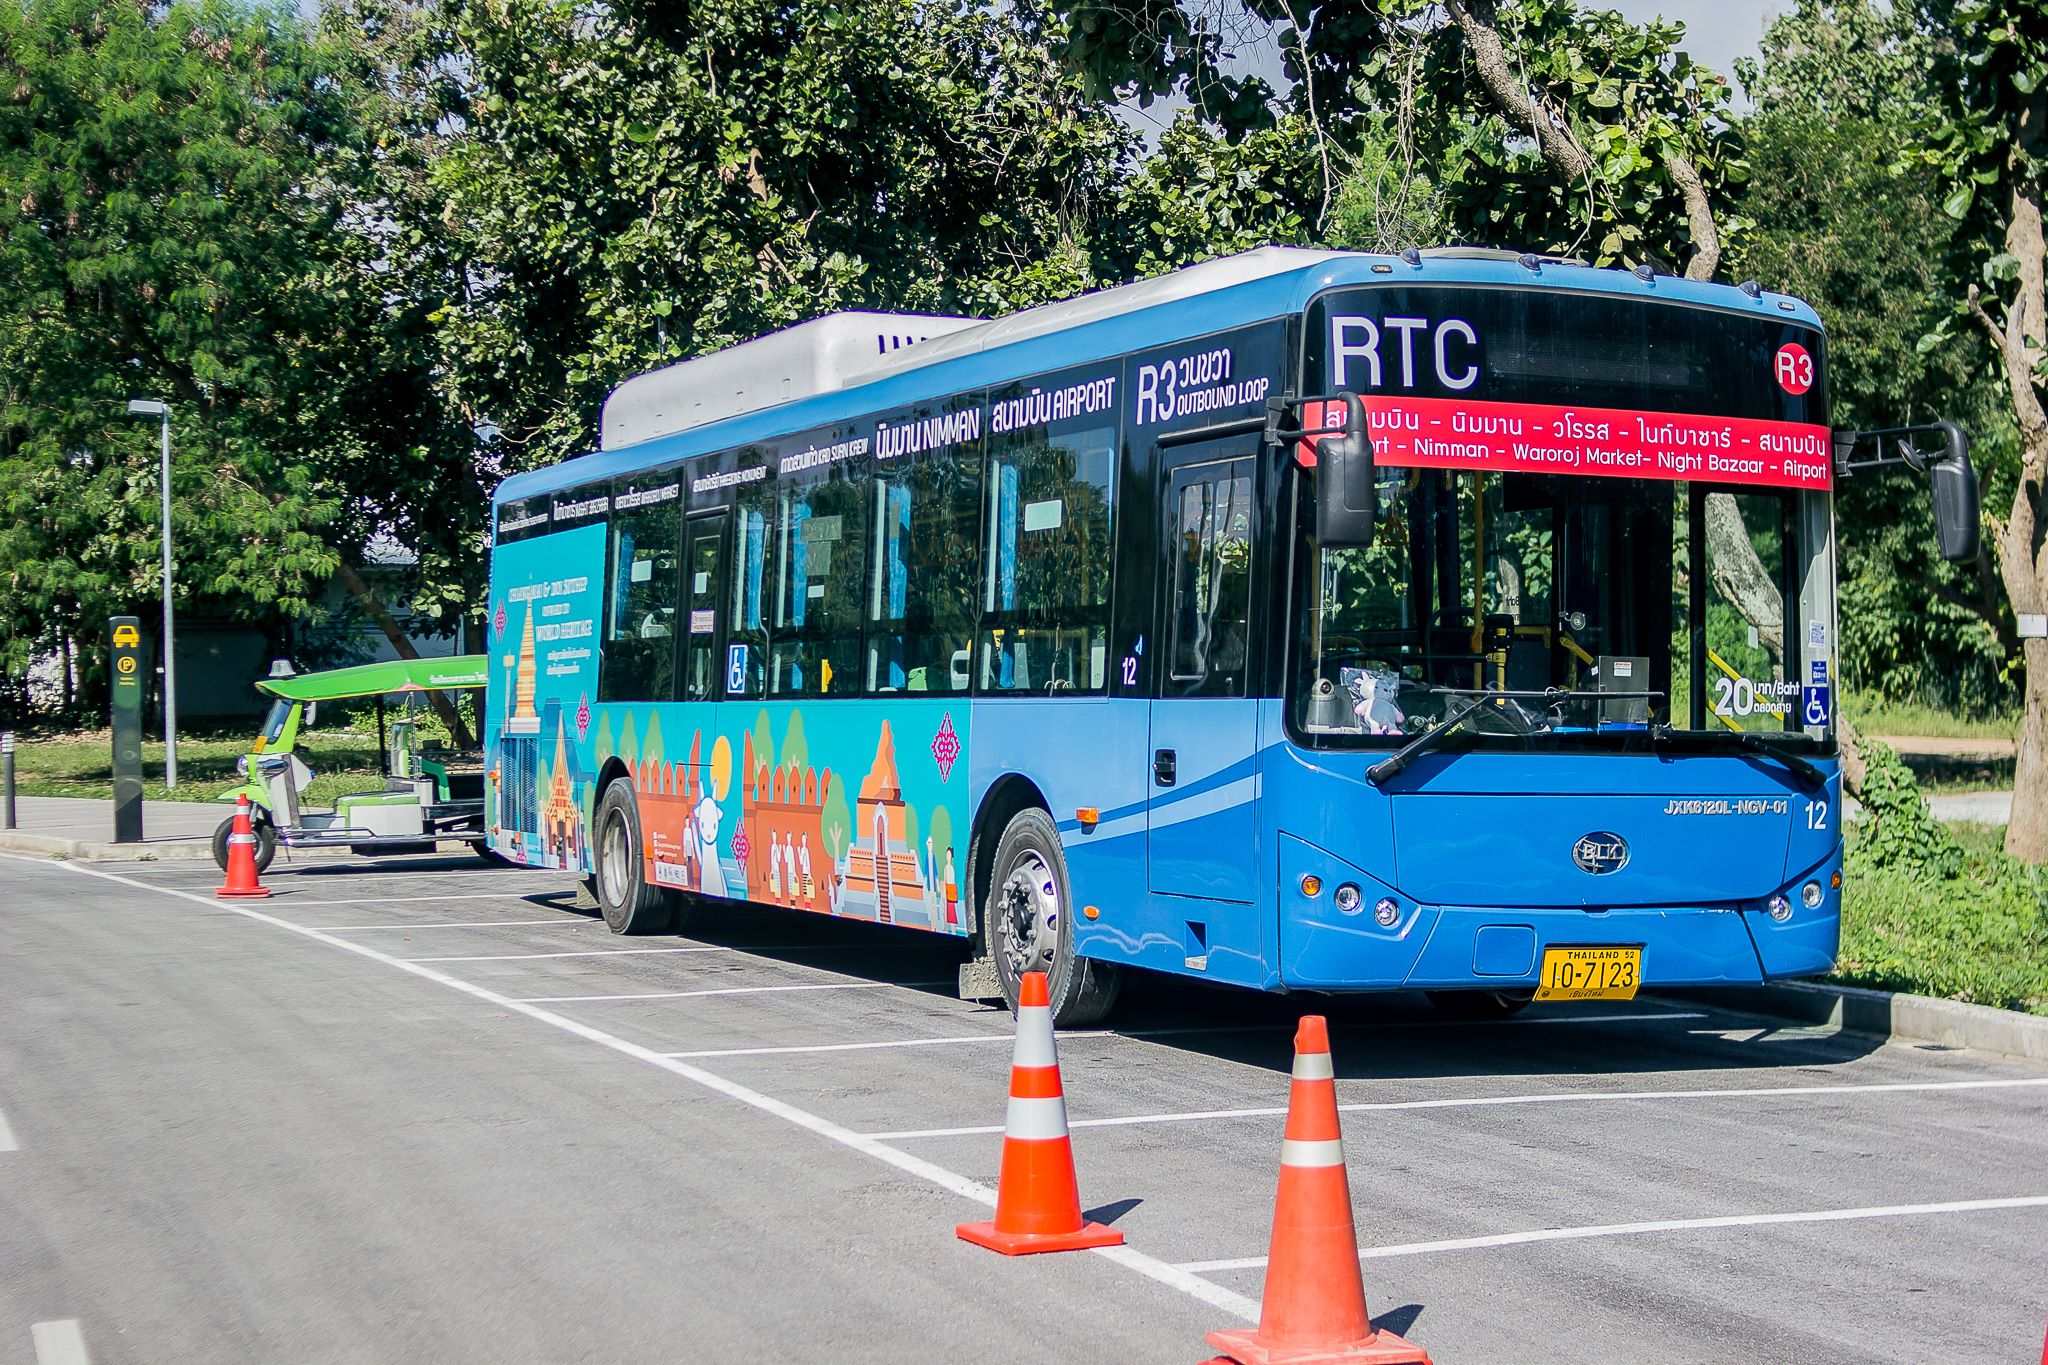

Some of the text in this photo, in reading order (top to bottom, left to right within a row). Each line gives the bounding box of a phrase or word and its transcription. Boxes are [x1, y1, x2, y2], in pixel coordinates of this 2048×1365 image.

[1179, 348, 1231, 388] วนขวา
[1332, 316, 1478, 389] RTC
[1777, 352, 1813, 387] R3
[992, 376, 1116, 432] สนามบิน AIRPORT
[1136, 360, 1177, 425] R3
[1177, 377, 1269, 416] OUTBOUND LOOP
[876, 407, 980, 459] นิมมาน NIMMAN
[1452, 411, 1522, 435] นิมมาน
[1552, 412, 1609, 441] วโรรส
[1636, 417, 1732, 448] ไนท์บาซาร์
[1760, 433, 1827, 458] สนามบิน
[1414, 438, 1489, 458] Nimman
[1512, 442, 1581, 467] Waroroj
[1658, 451, 1703, 472] Night
[1708, 454, 1764, 474] Bazaar
[1784, 462, 1827, 481] Airport
[1122, 656, 1136, 685] 12
[1714, 677, 1754, 716] 20
[1804, 800, 1828, 830] 12
[1552, 961, 1634, 988] 10-7123
[1567, 950, 1635, 960] THAILAND 52
